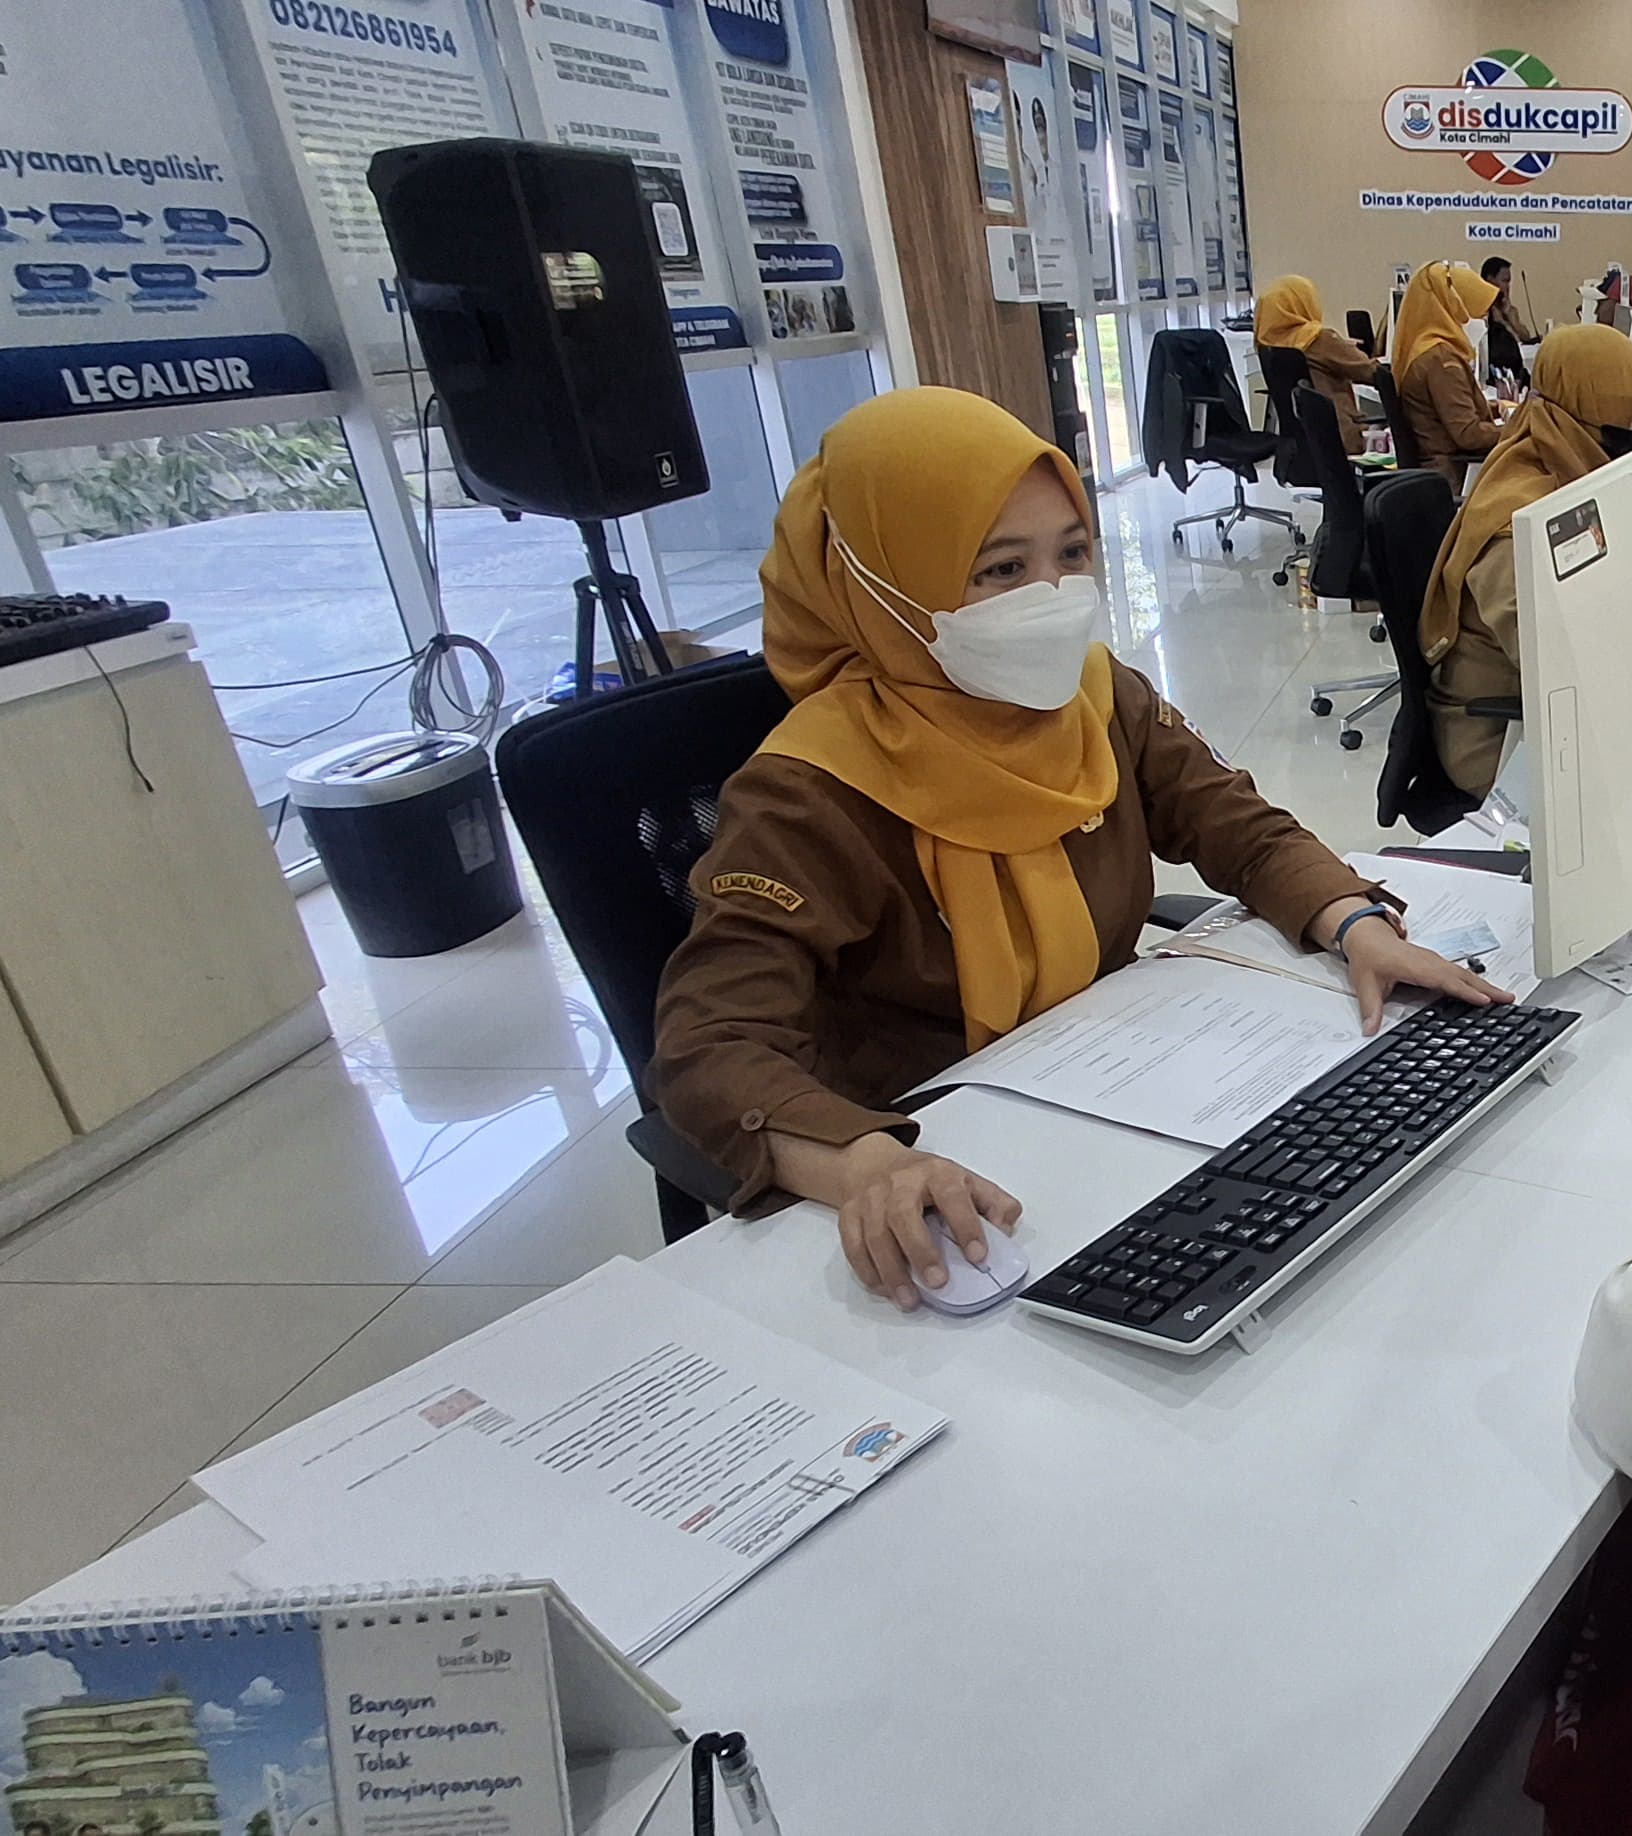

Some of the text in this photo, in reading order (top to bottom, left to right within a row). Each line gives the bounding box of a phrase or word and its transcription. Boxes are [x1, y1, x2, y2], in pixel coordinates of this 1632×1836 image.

[269, 0, 457, 57] 082126861954
[1438, 100, 1617, 138] disdukcapil
[1440, 132, 1510, 143] Kota Cimahi
[106, 152, 224, 186] Legalisir:
[1362, 193, 1403, 207] Dinas
[1406, 193, 1517, 211] Kependudukan
[1520, 194, 1548, 208] dan
[1468, 224, 1556, 239] Kota Cimahi
[61, 356, 254, 405] LEGALISIR
[715, 874, 799, 908] KEMENDAGRI
[349, 1694, 435, 1718] Bangun
[355, 1751, 413, 1773] Tolak
[357, 1775, 523, 1803] Penyimpangan
